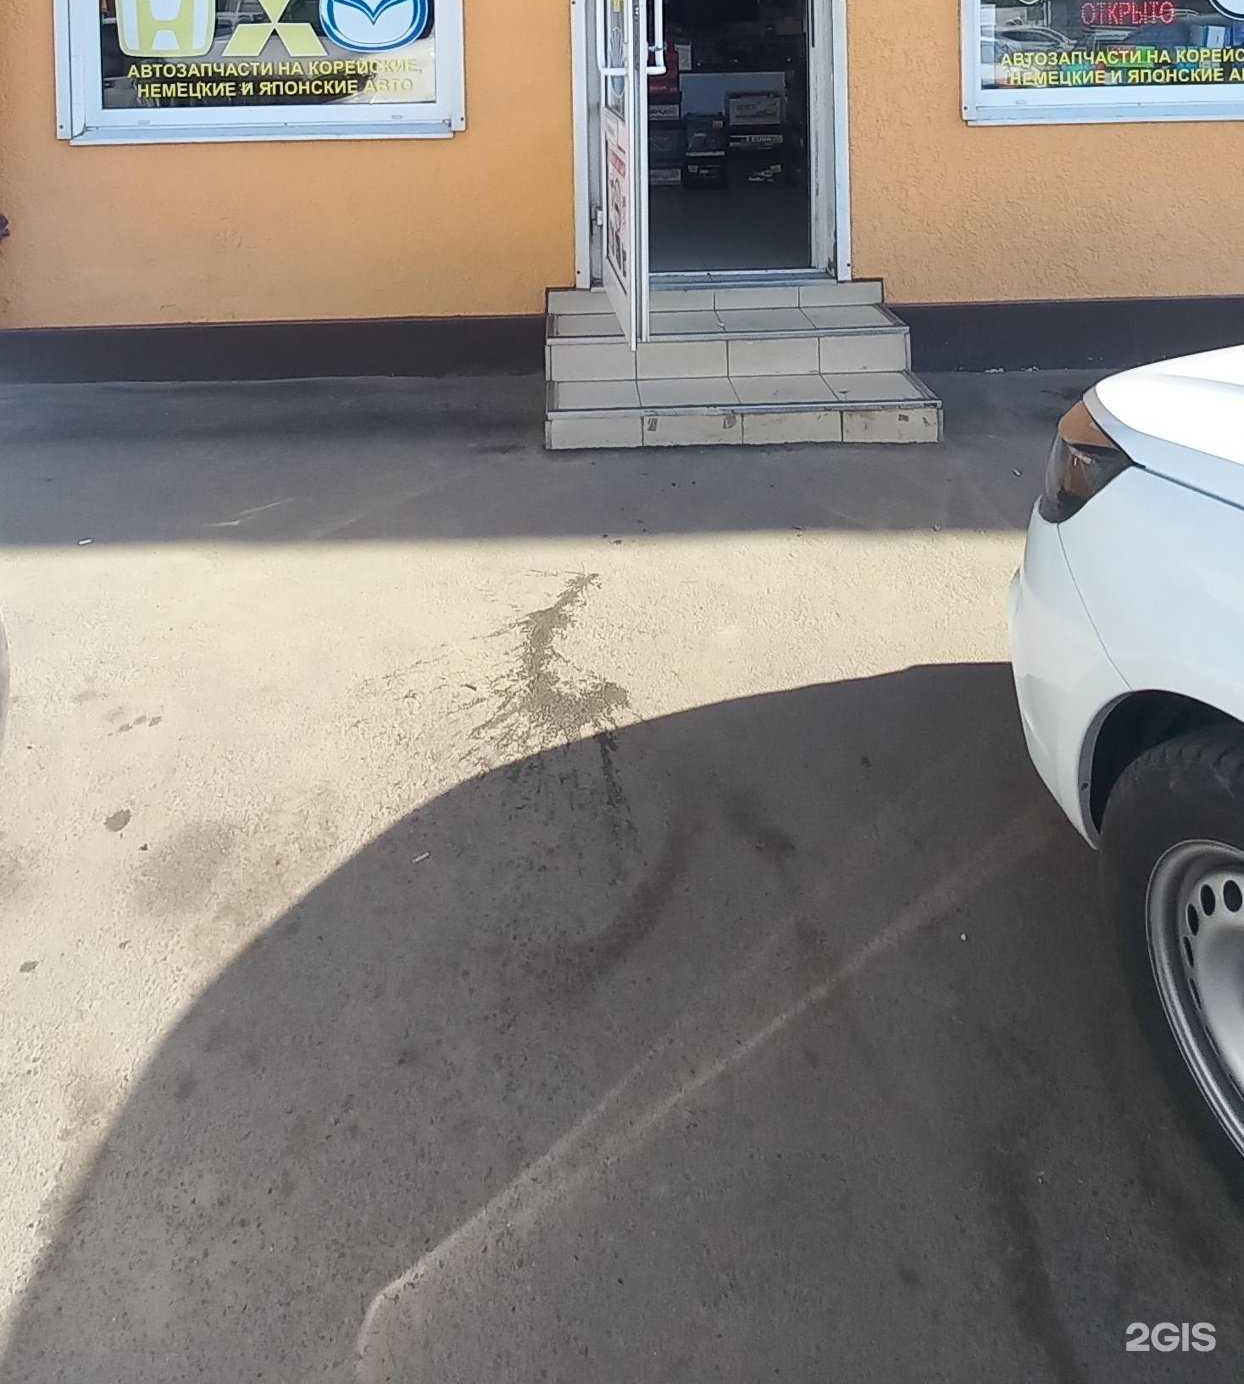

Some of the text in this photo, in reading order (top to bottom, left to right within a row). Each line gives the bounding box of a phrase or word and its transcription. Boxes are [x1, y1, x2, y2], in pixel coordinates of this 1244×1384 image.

[1080, 1, 1176, 25] ОТКРЫТО
[1000, 45, 1244, 67] АВТОЗАПЧАСТИ НА КОРЕЙС
[127, 60, 273, 78] АВТОЗАПЧАСТИ
[277, 60, 303, 77] НА
[1010, 69, 1105, 86] НЕМЕЦКИЕ
[1111, 70, 1123, 83] И
[1128, 67, 1224, 83] ЯПОНСКИЕ
[136, 81, 236, 100] НЕМЕЦКИЕ
[241, 81, 254, 97] И
[259, 79, 357, 96] ЯПОНСКИЕ
